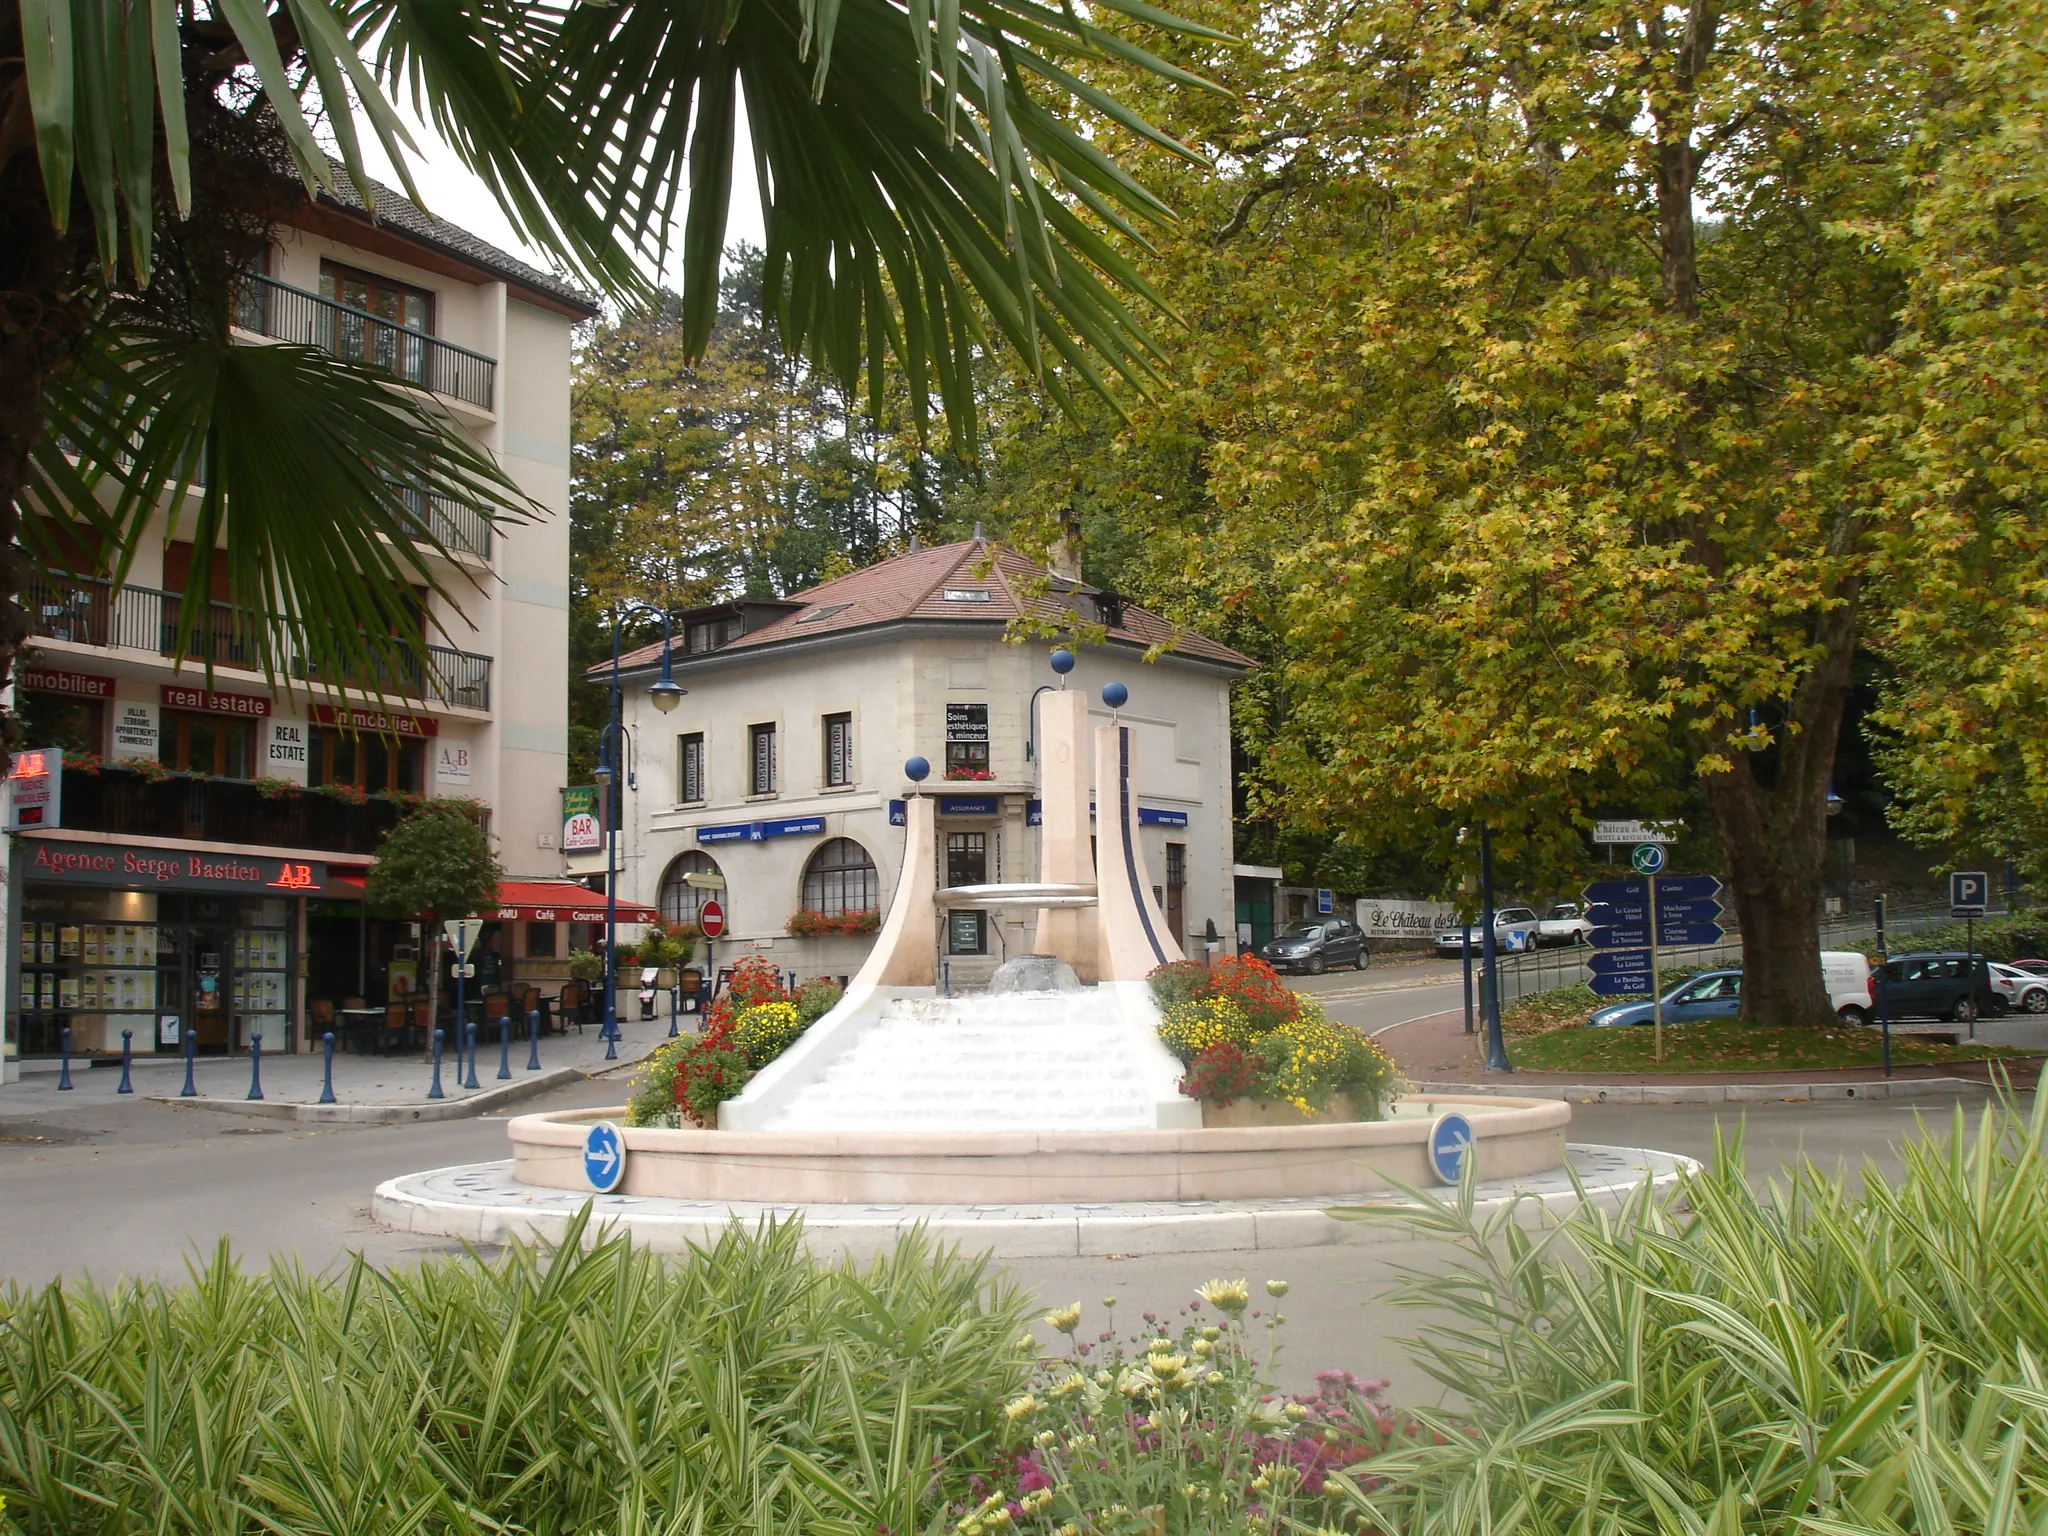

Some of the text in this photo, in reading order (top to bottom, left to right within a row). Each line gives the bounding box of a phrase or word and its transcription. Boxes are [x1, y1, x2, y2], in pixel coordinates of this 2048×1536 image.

[168, 690, 265, 715] real estate
[127, 707, 147, 718] VILLAS
[947, 712, 968, 721] Soins
[123, 716, 151, 727] TERRAINS
[947, 722, 988, 731] esthétiques
[115, 725, 158, 738] APPARTEMENTS
[276, 726, 301, 743] REAL
[947, 731, 987, 740] & minceur
[118, 735, 154, 747] COMMERCES
[270, 744, 305, 762] ESTATE
[833, 726, 842, 780] EPILATION
[572, 818, 592, 836] BAR
[33, 845, 262, 881] Agence Serge Bastien
[1961, 879, 1977, 900] P
[497, 909, 604, 921] PMU Café Courses
[1390, 911, 1431, 928] Château
[1434, 910, 1447, 928] de
[1614, 975, 1646, 984] Le Pavillon
